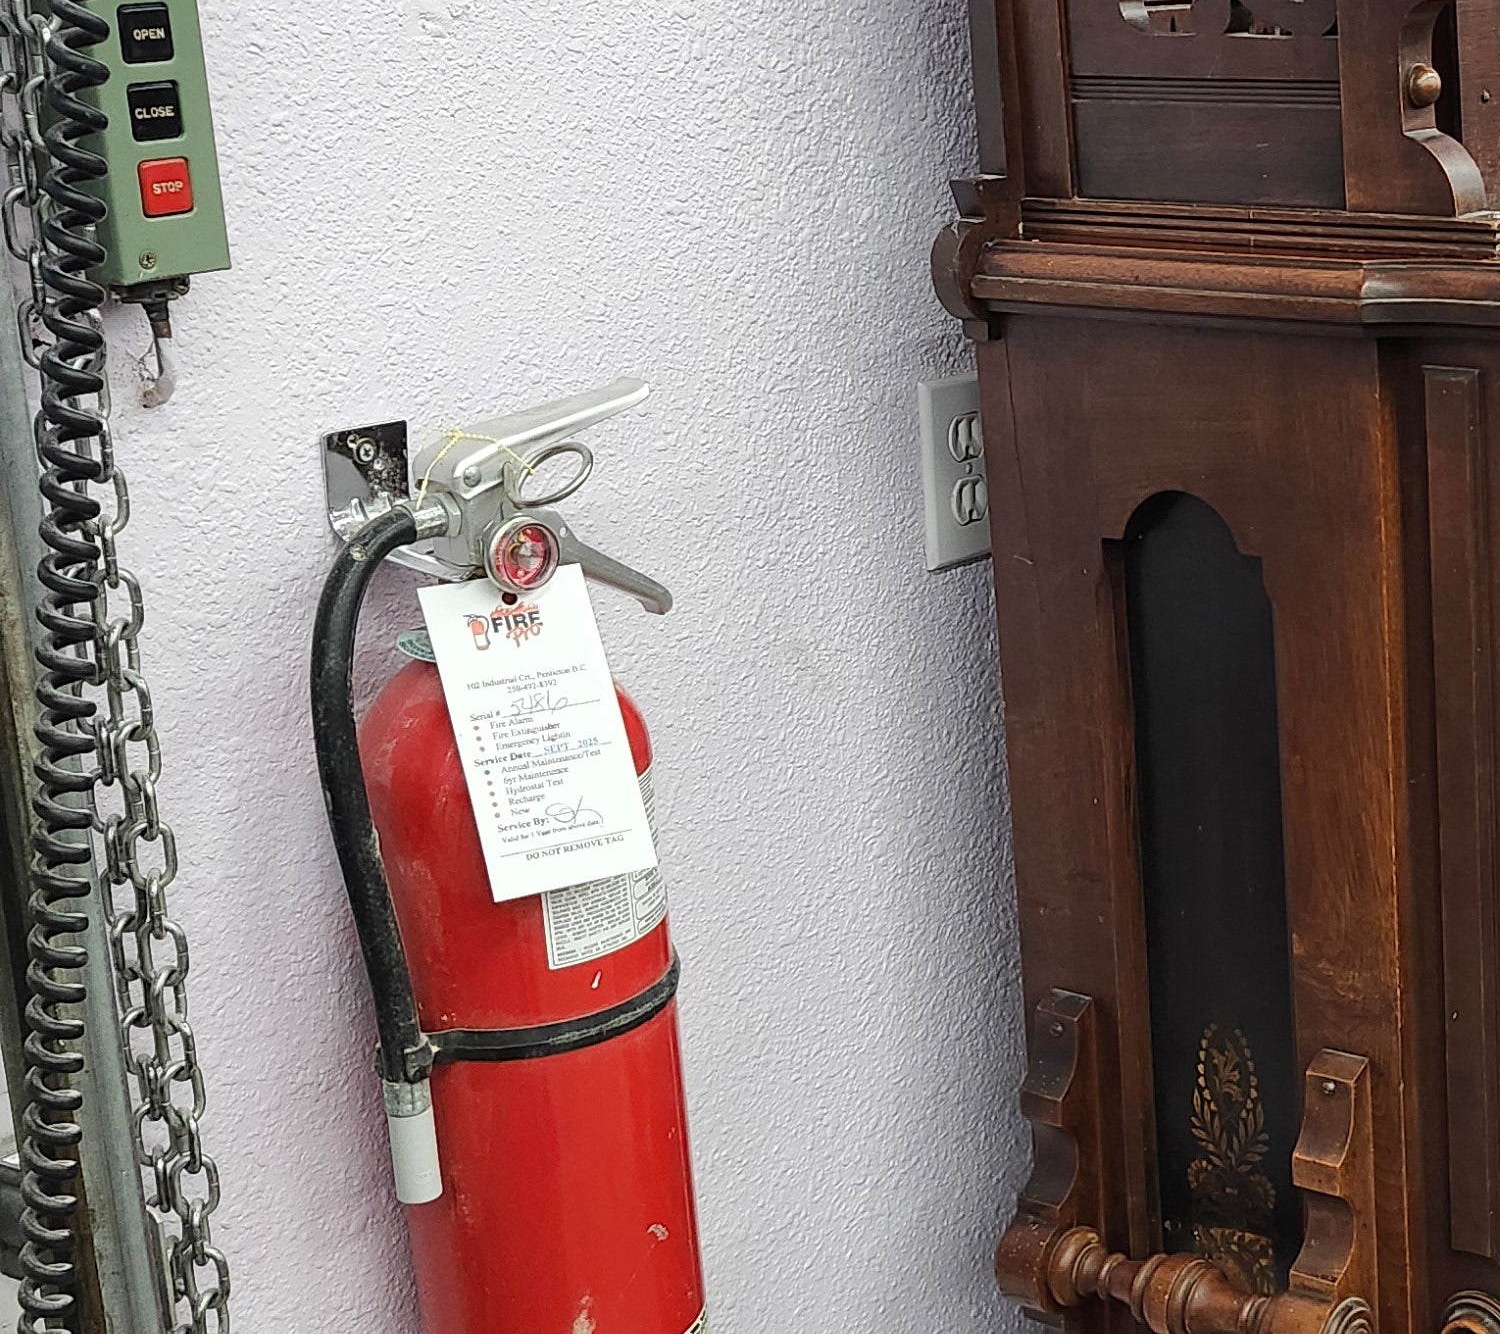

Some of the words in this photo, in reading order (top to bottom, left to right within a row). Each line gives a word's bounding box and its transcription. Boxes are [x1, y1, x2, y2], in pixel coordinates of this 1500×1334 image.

[132, 27, 165, 41] OPEN
[134, 105, 174, 119] CLOSE
[152, 181, 184, 195] STOP
[491, 611, 543, 633] FIRE
[506, 624, 541, 648] Pro
[466, 682, 480, 690] 102
[482, 675, 518, 688] Industrial
[470, 711, 494, 721] Serial
[490, 721, 506, 729] Fire
[508, 717, 534, 727] Alarm
[492, 732, 509, 740] Fire
[510, 723, 560, 737] Extinguisher
[496, 737, 539, 751] Emergency
[474, 755, 508, 767] Service
[510, 751, 532, 761] Date
[544, 743, 569, 755] SEPT
[577, 737, 599, 748] 2025
[502, 761, 530, 773] Annual
[532, 749, 601, 767] Maintenance/Test
[518, 767, 569, 781] Maintenance
[546, 779, 564, 787] Test
[508, 793, 546, 805] Recharge
[510, 808, 530, 816] New
[498, 821, 531, 833] Service
[533, 817, 550, 827] By:
[502, 835, 519, 843] Valid
[552, 825, 567, 833] from
[568, 822, 586, 830] above
[526, 851, 540, 861] DO
[542, 847, 562, 857] NOT
[563, 839, 603, 853] REMOVE
[604, 834, 624, 845] TAG
